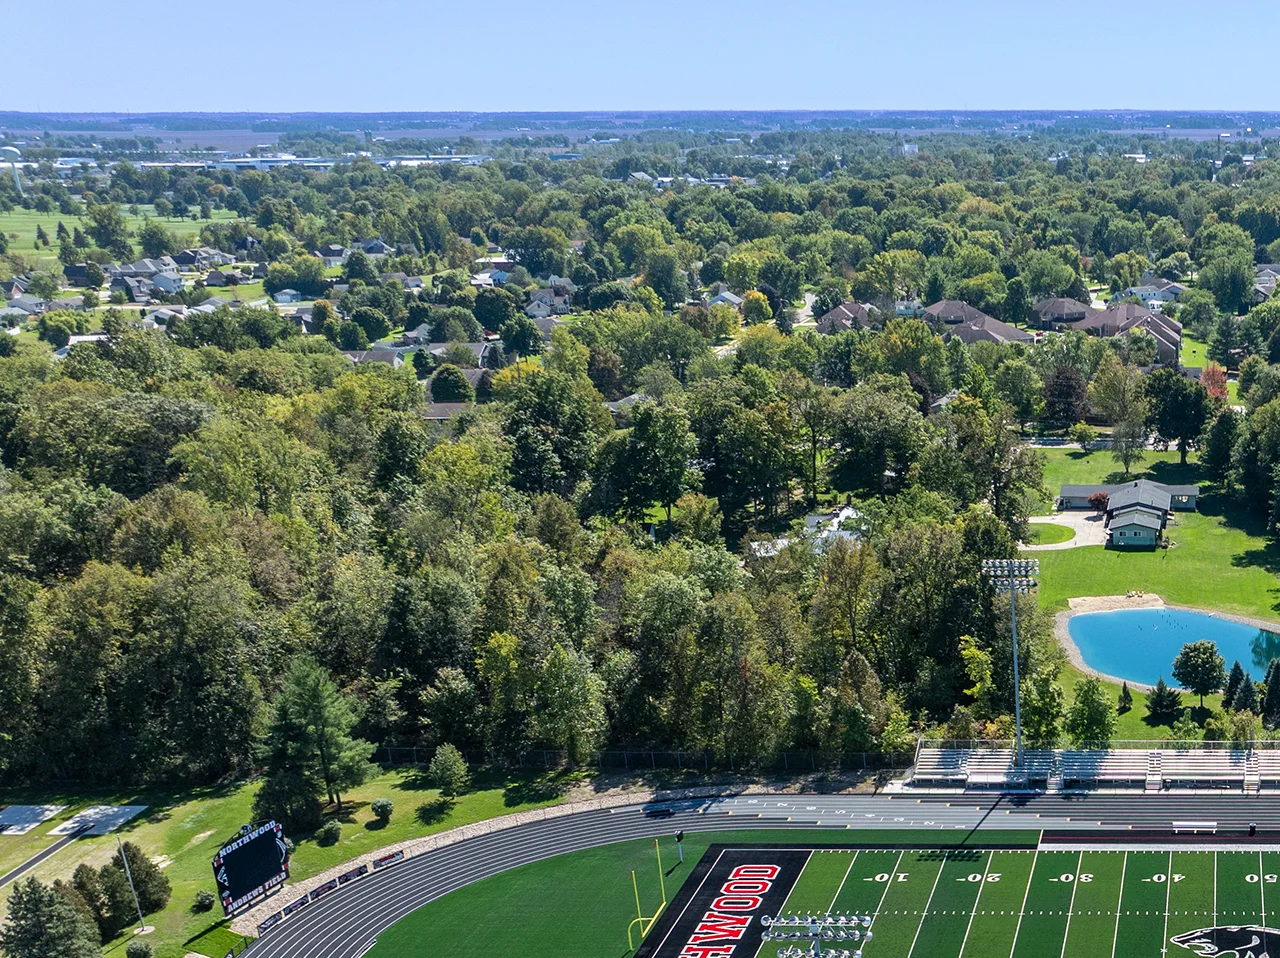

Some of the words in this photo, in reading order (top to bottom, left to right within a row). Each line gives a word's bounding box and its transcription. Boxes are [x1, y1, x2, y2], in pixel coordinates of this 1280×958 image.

[219, 820, 276, 858] NORTHWOOD
[874, 873, 909, 883] 10
[967, 873, 1002, 883] 20
[1060, 873, 1094, 883] 30
[1152, 873, 1187, 883] 40
[1245, 873, 1278, 883] 50
[228, 885, 264, 913] ANDREWS
[264, 871, 287, 889] FIELD
